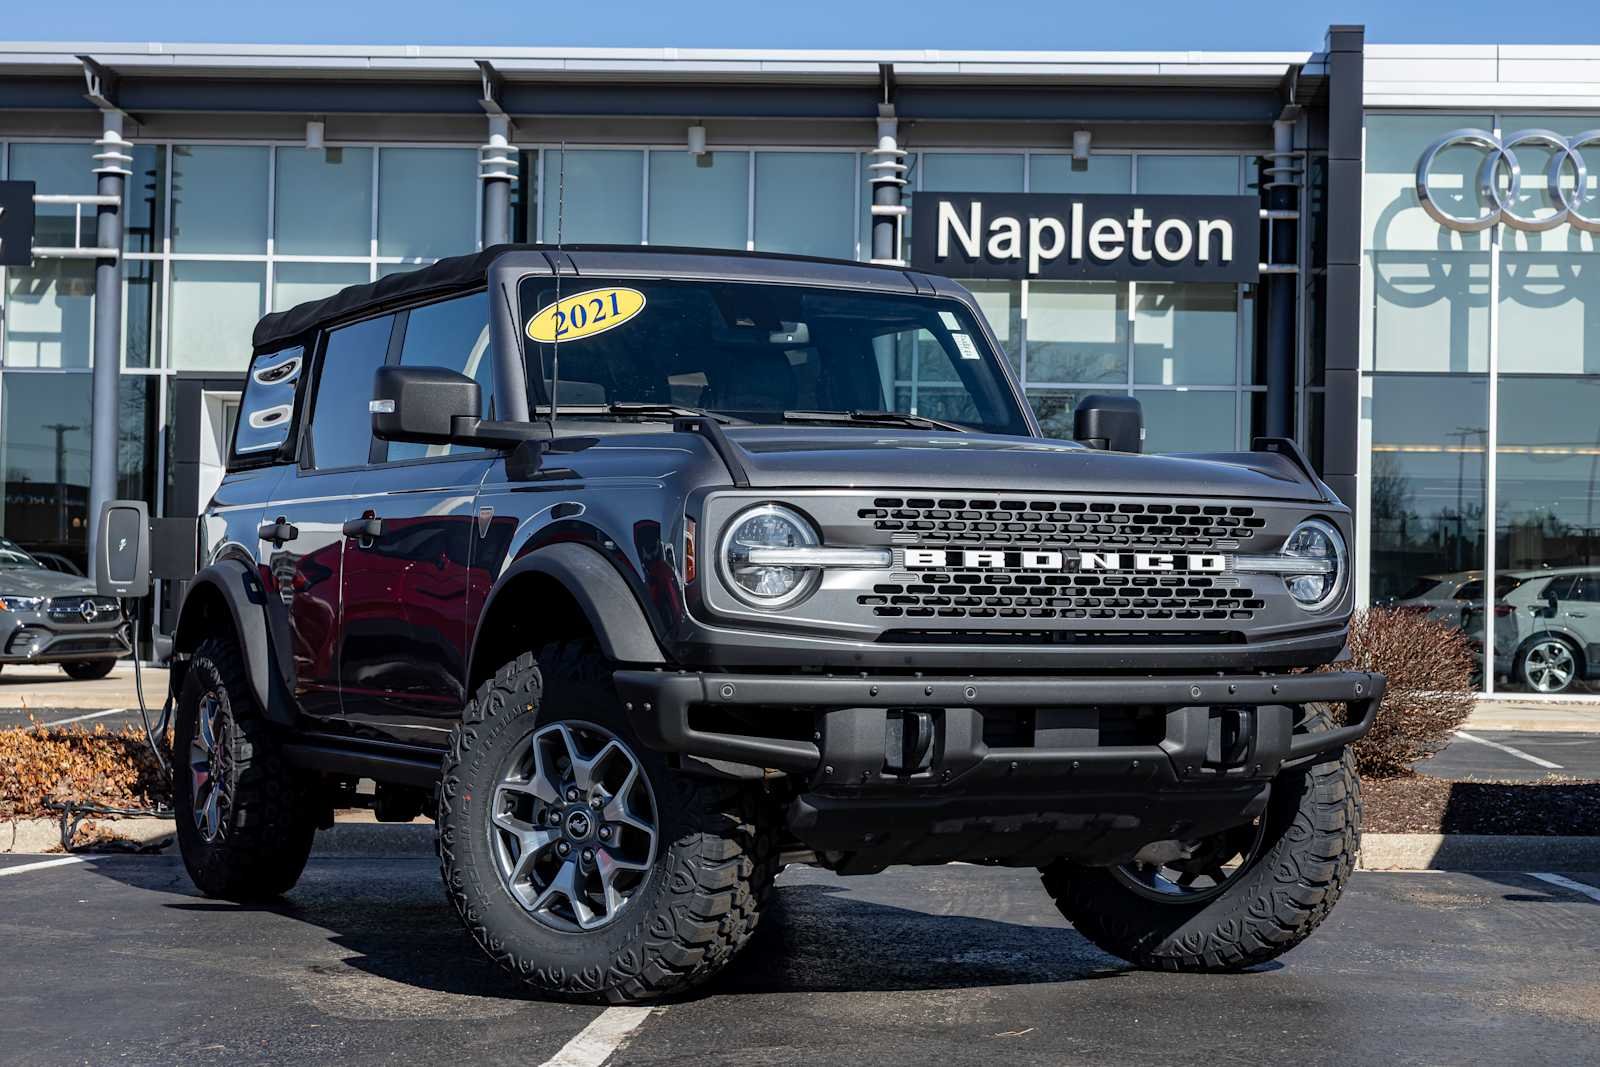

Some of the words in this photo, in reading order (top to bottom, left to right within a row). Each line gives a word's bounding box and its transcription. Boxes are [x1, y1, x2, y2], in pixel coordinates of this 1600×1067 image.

[937, 201, 1234, 275] Napleton
[551, 292, 622, 336] 2021
[904, 549, 1226, 571] BRONCO
